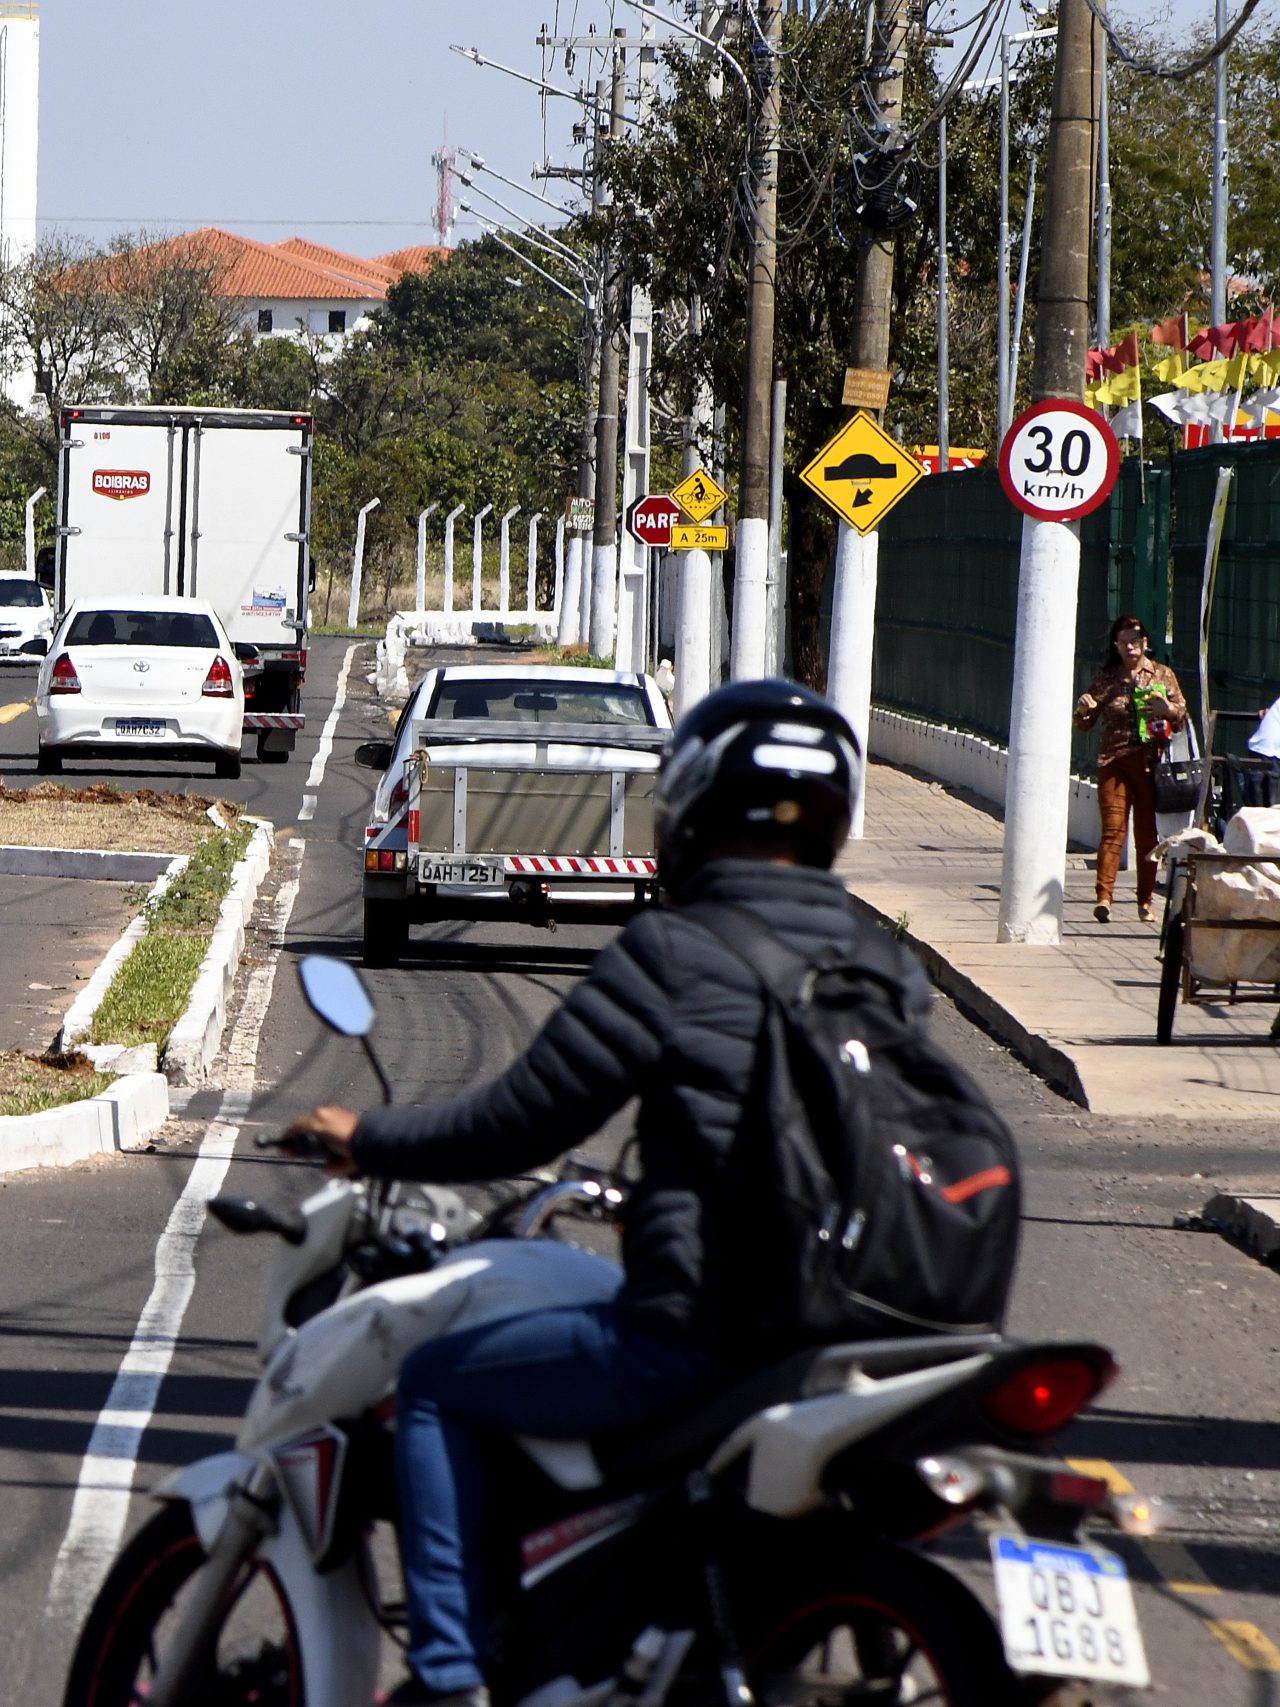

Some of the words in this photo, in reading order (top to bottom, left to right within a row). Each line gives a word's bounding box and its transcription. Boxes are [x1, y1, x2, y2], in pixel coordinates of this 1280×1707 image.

[1024, 425, 1091, 477] 30
[95, 474, 148, 490] BOIBRAS
[1024, 479, 1085, 500] km/h
[636, 512, 680, 529] PARE
[680, 532, 689, 543] A
[694, 533, 718, 543] 25m
